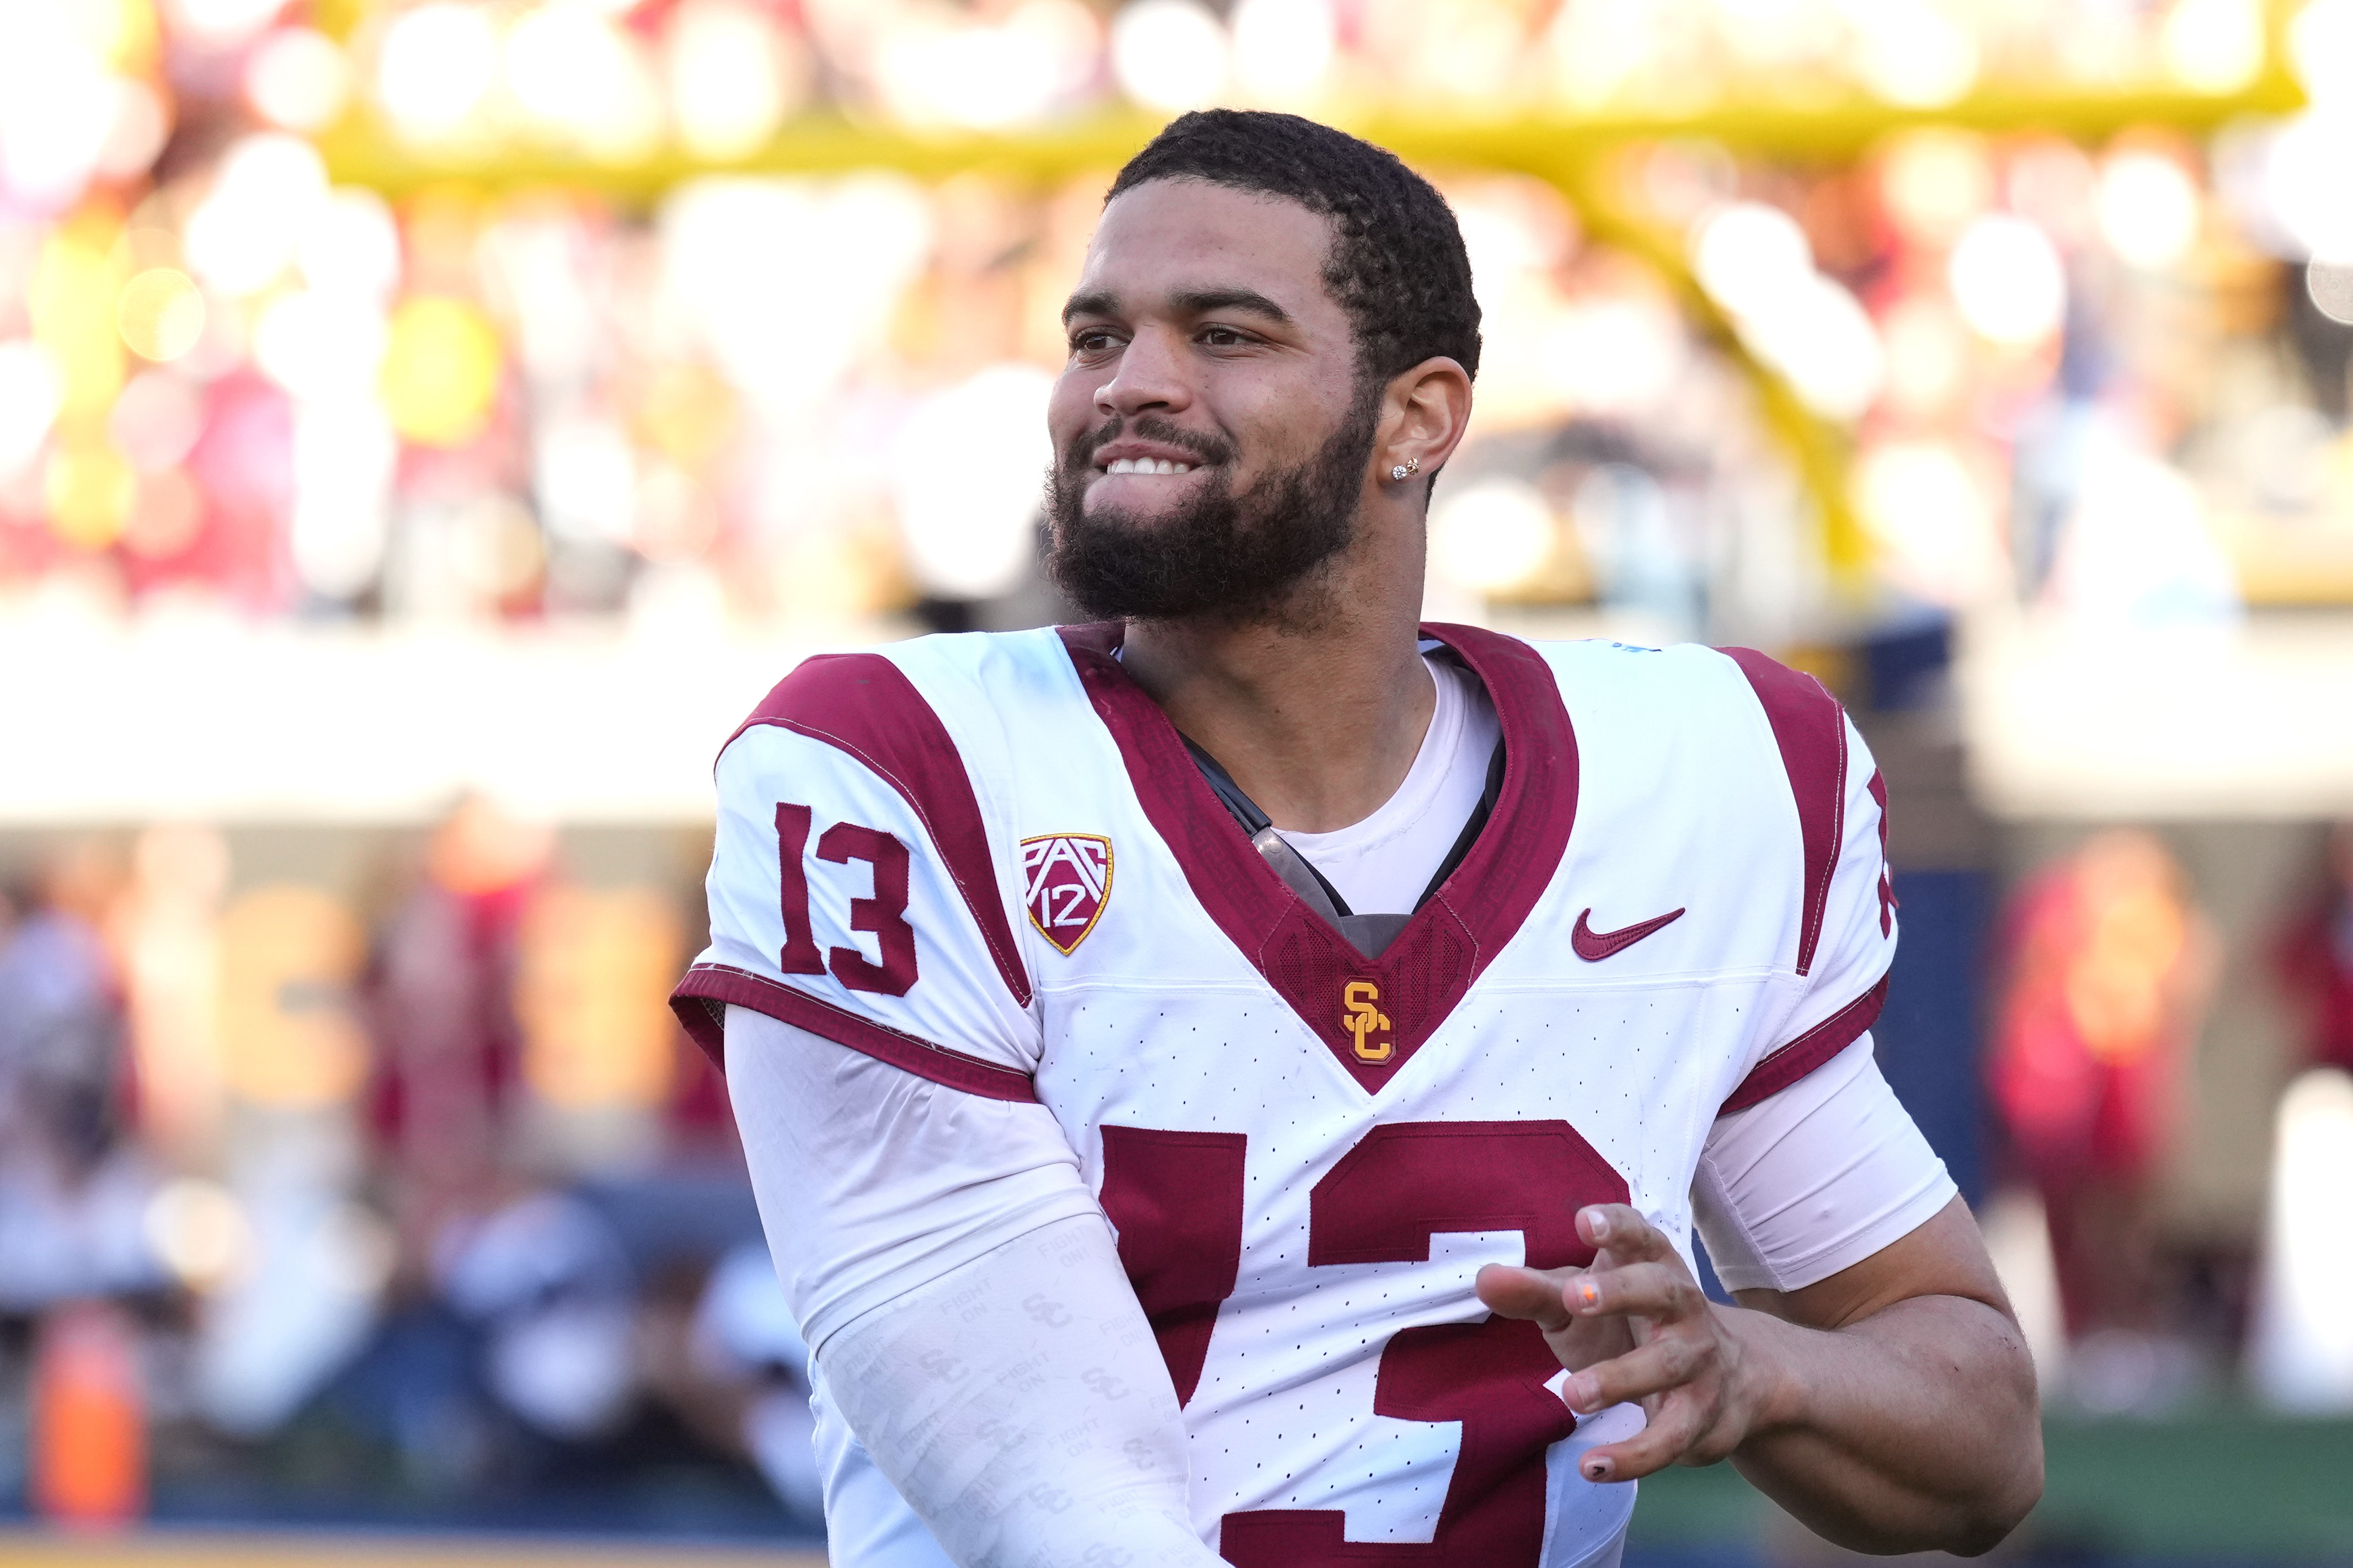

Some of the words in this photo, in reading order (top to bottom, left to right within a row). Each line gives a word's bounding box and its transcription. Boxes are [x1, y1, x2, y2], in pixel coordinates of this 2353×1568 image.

[1021, 838, 1106, 908] PAC
[775, 802, 919, 997] 13
[1041, 884, 1088, 928] 12
[1343, 982, 1390, 1058] SC
[1037, 1224, 1086, 1259] FIGHT
[937, 1277, 992, 1315] FIGHT
[1022, 1292, 1074, 1329] SC
[1098, 1120, 1631, 1568] 13
[916, 1348, 971, 1384] SC
[994, 1350, 1050, 1387] FIGHT
[1080, 1367, 1131, 1401] SC
[1047, 1417, 1101, 1451] FIGHT
[1027, 1482, 1074, 1515] SC
